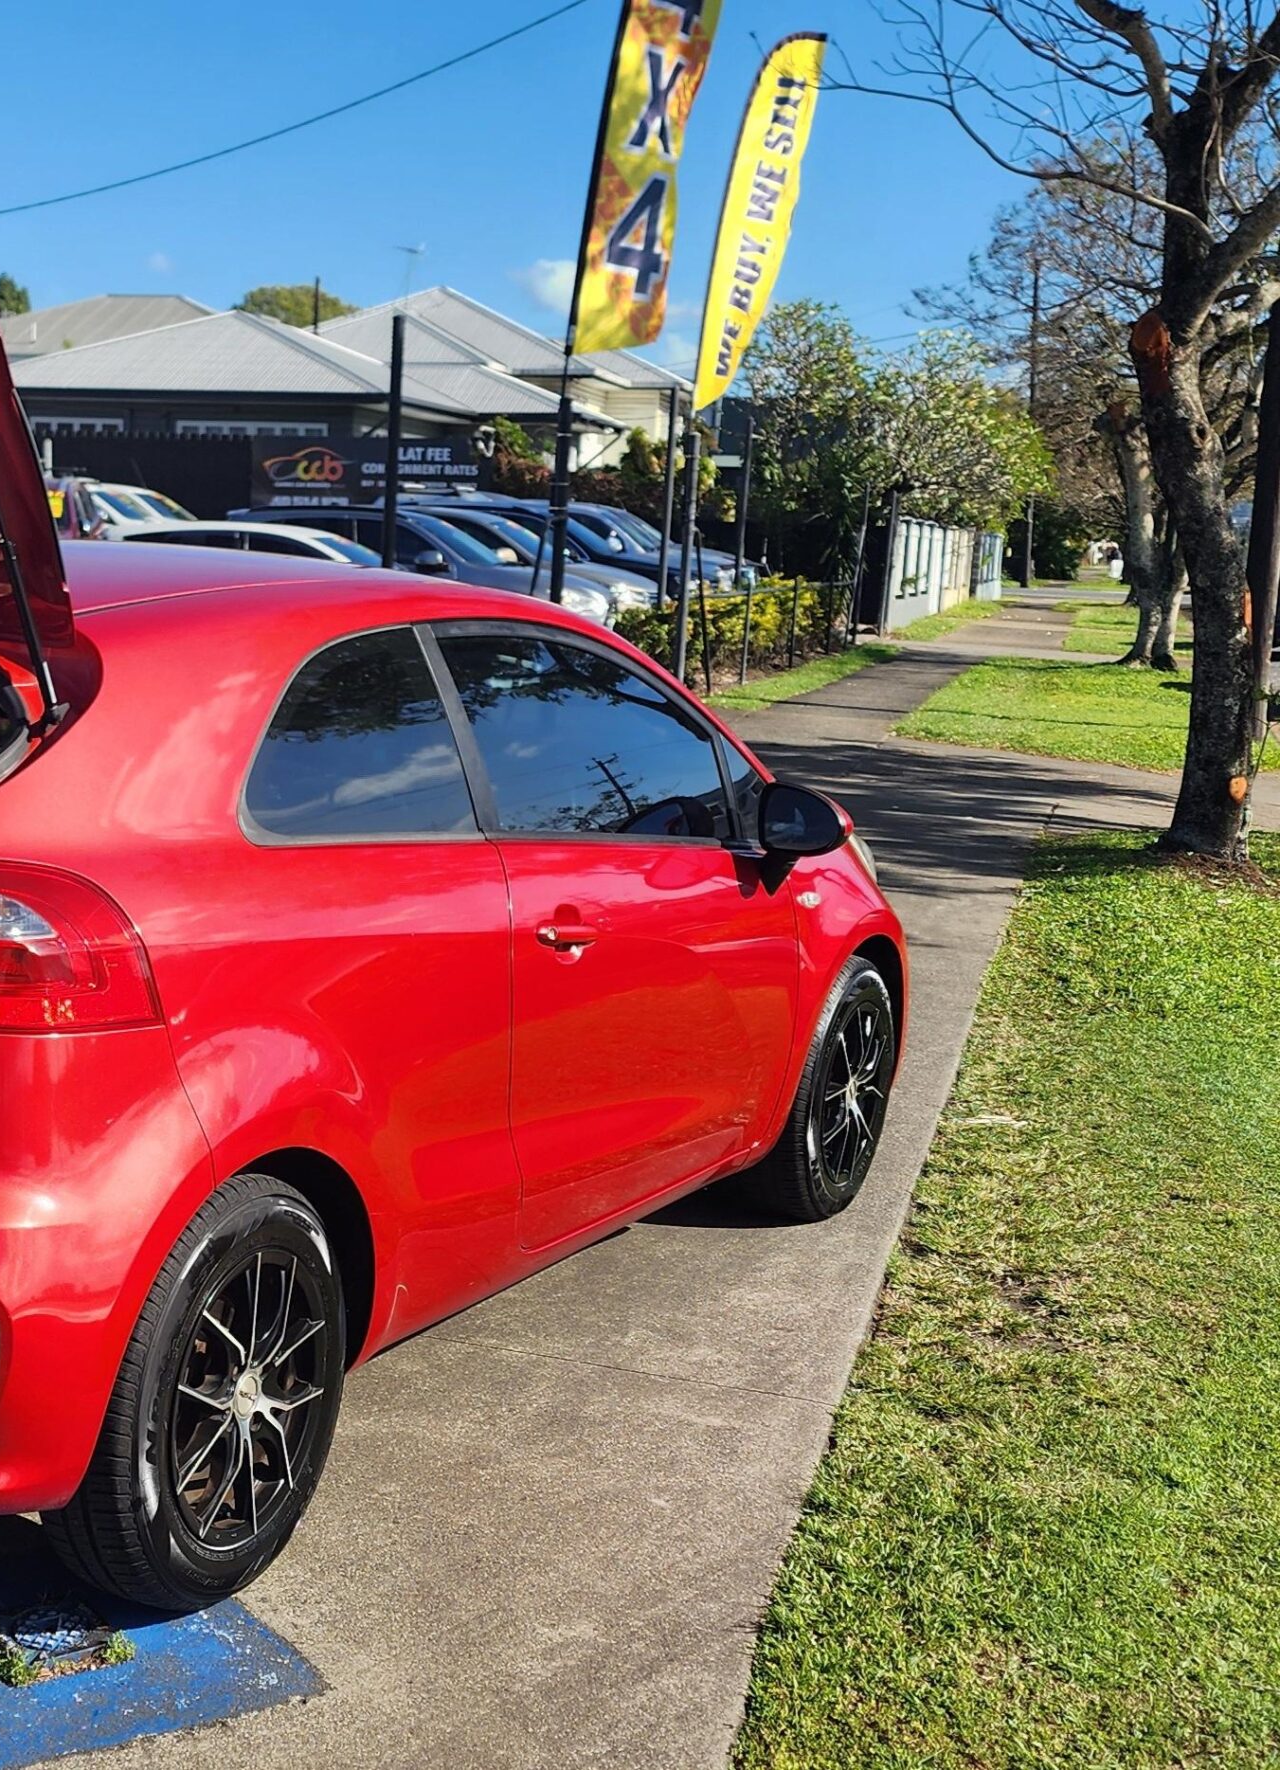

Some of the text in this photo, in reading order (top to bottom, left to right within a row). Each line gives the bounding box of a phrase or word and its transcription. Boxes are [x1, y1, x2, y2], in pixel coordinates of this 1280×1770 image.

[764, 77, 806, 155] SELL
[747, 160, 788, 223] WE
[715, 321, 742, 377] WE
[397, 447, 452, 461] LAT FEE
[443, 464, 479, 476] RATES
